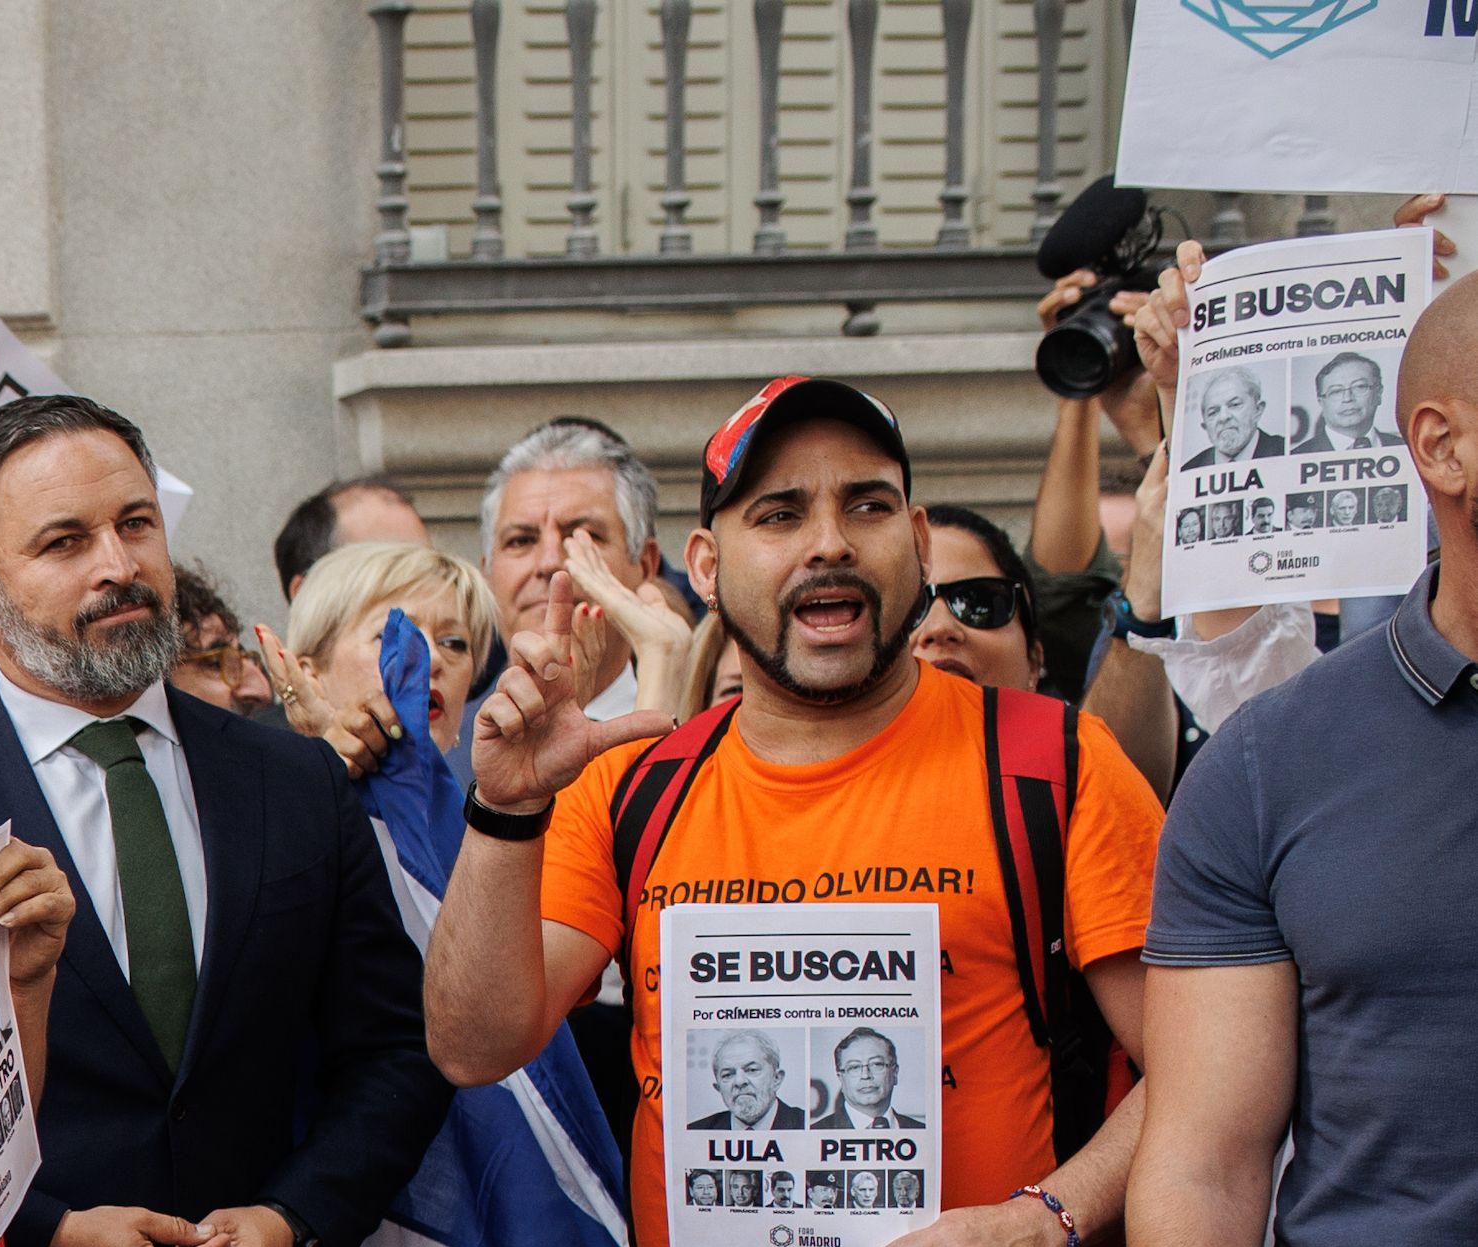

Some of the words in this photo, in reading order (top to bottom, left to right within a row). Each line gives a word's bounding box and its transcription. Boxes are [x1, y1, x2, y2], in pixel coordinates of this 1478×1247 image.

[1194, 296, 1226, 332] SE
[1234, 273, 1405, 321] BUSCAN
[1205, 343, 1263, 363] CRÍMENES
[1266, 338, 1303, 351] contra
[1306, 336, 1317, 347] la
[1321, 328, 1407, 345] DEMOCRACIA
[1195, 468, 1264, 498] LULA
[1300, 455, 1400, 484] PETRO
[1277, 555, 1319, 571] MADRID
[813, 866, 975, 899] OLVIDAR!
[690, 951, 740, 983] SE
[750, 950, 916, 983] BUSCAN
[693, 1009, 713, 1020] Por
[716, 1006, 781, 1019] CRÍMENES
[784, 1008, 821, 1019] contra
[824, 1007, 835, 1019] la
[838, 1007, 918, 1019] DEMOCRACIA
[708, 1140, 784, 1162] LULA
[821, 1138, 917, 1162] PETRO
[798, 1227, 814, 1235] FORO
[798, 1236, 841, 1247] MADRID
